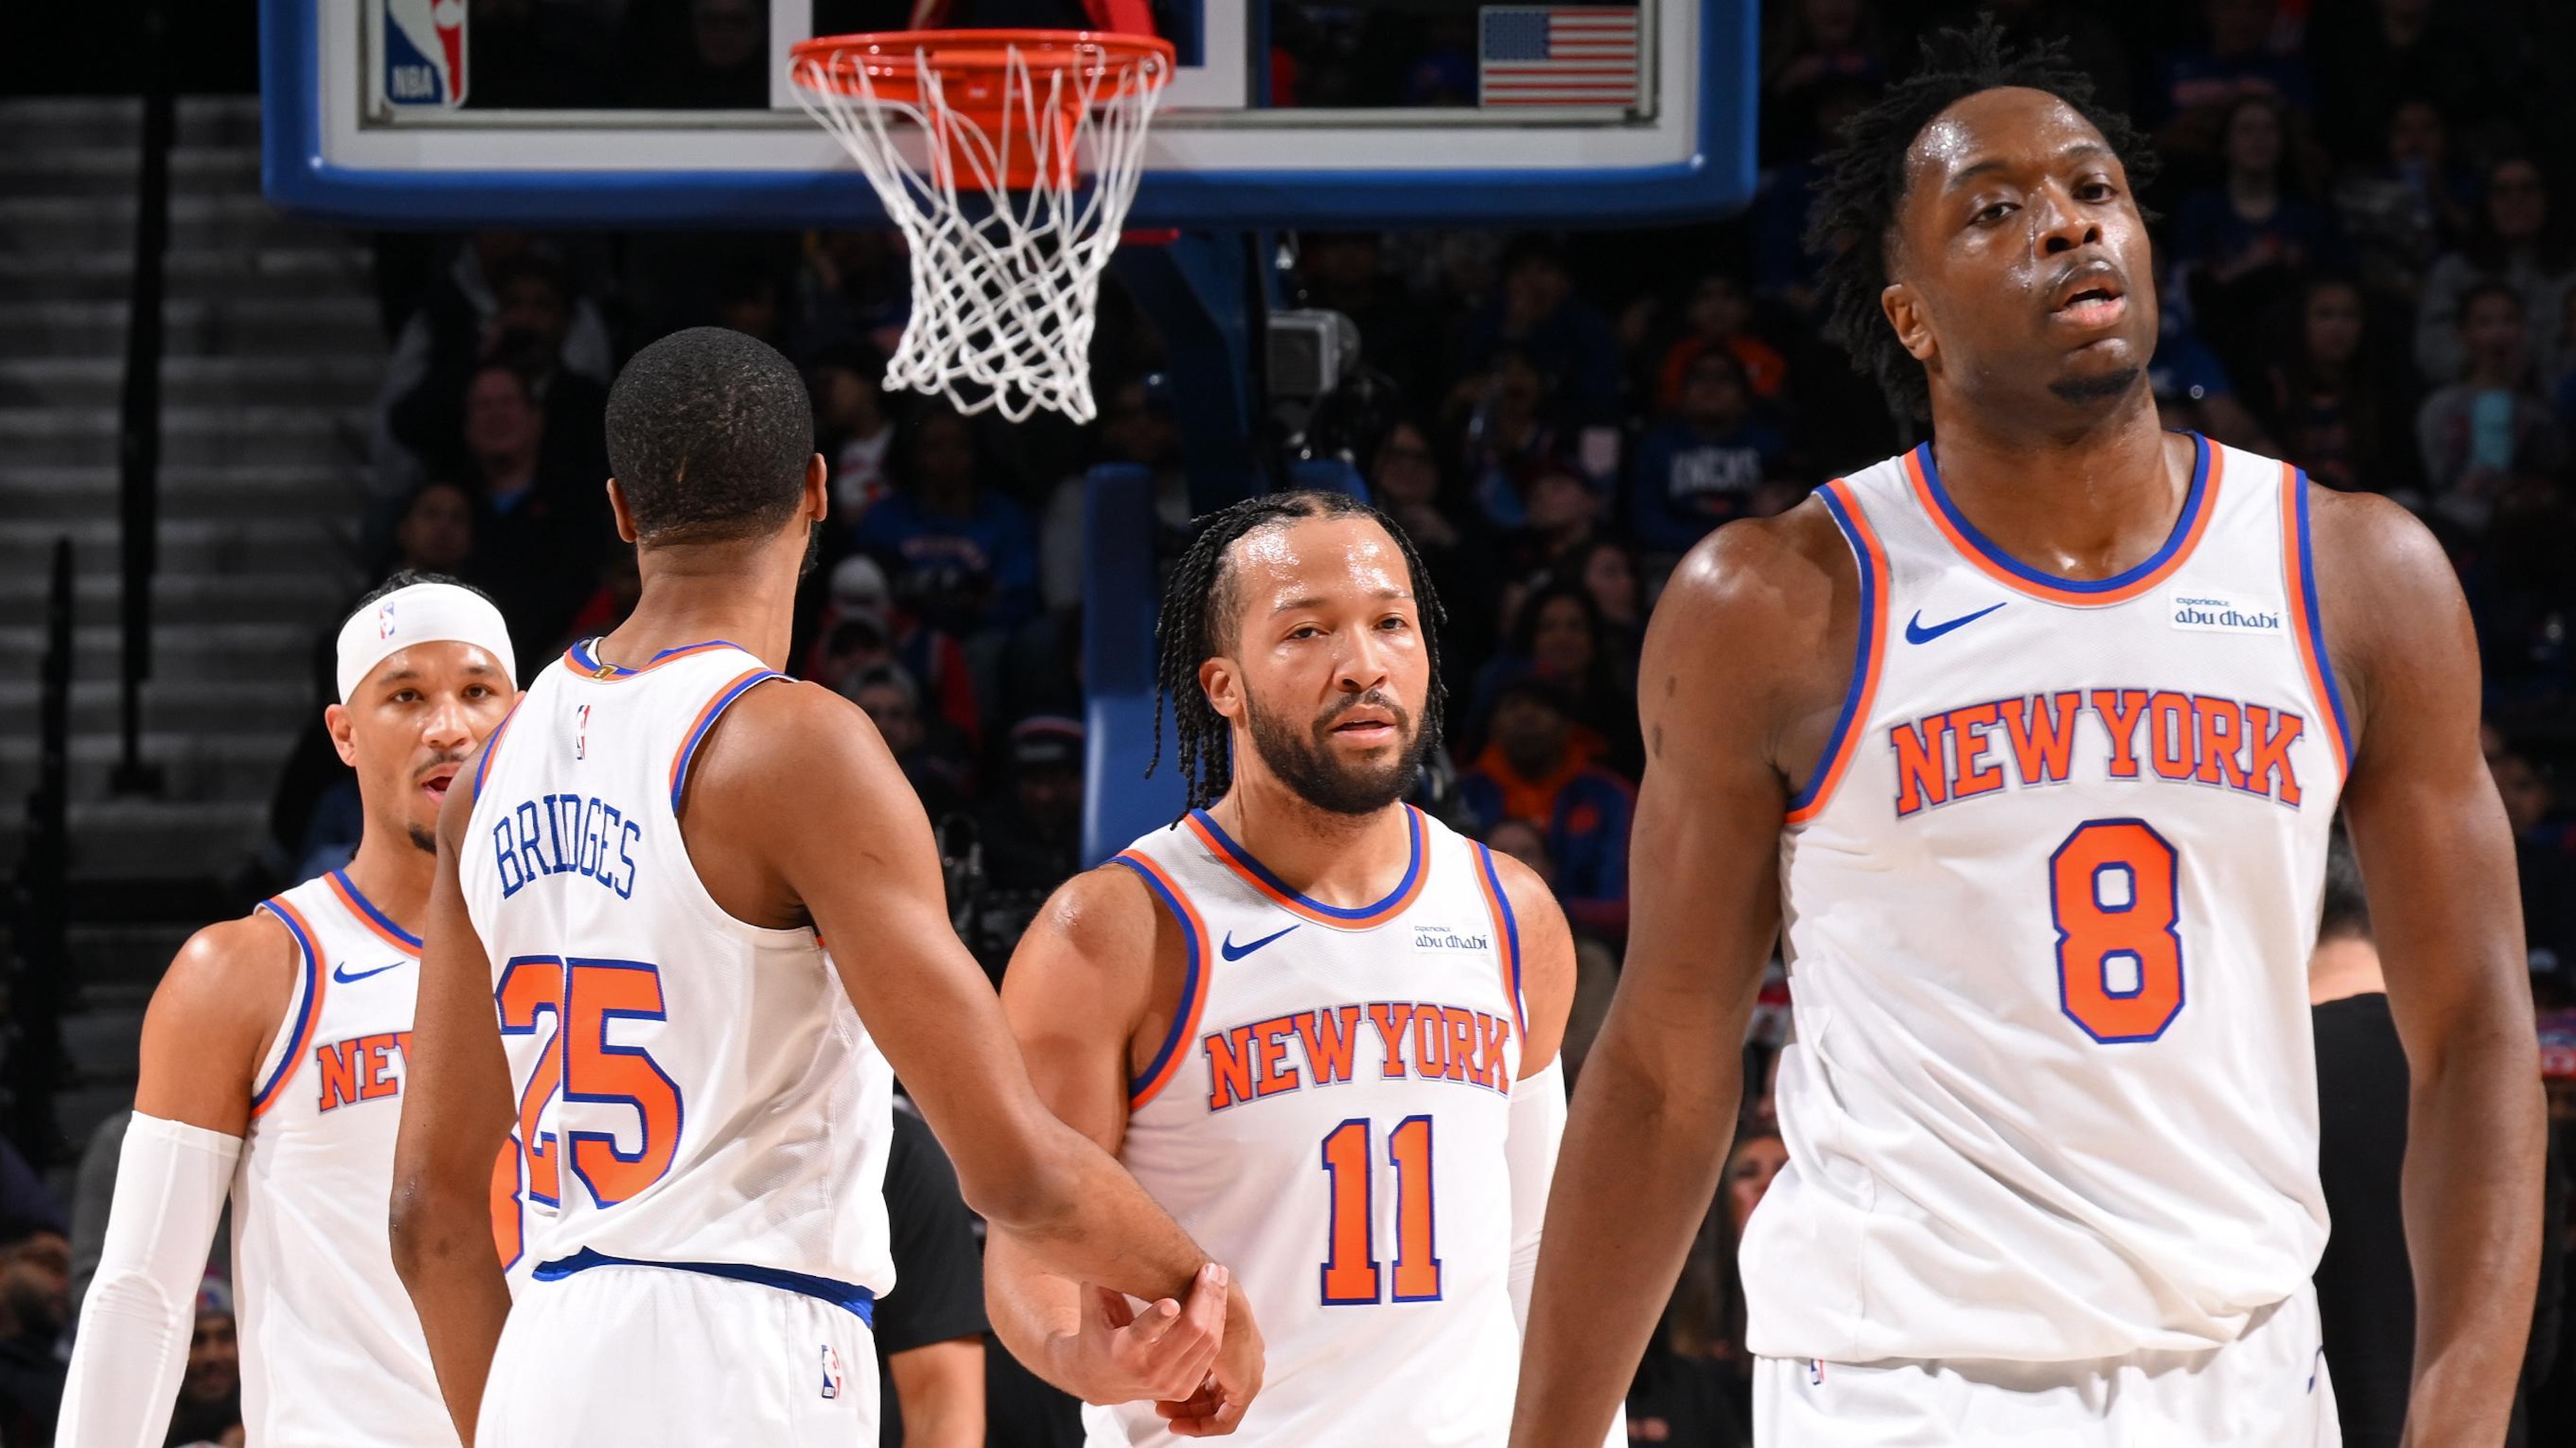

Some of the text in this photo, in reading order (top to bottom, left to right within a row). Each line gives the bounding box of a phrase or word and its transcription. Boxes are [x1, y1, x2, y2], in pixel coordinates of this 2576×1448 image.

[392, 65, 434, 99] NBA
[2176, 608, 2279, 629] abu dhabi
[1890, 688, 2304, 820] NEW YORK
[492, 794, 643, 900] BRIDGES
[1415, 934, 1487, 949] abu dhabi
[2049, 818, 2186, 1044] 8
[495, 954, 682, 1210] 25
[1201, 1000, 1513, 1113] NEW YORK
[1321, 1115, 1443, 1306] 11
